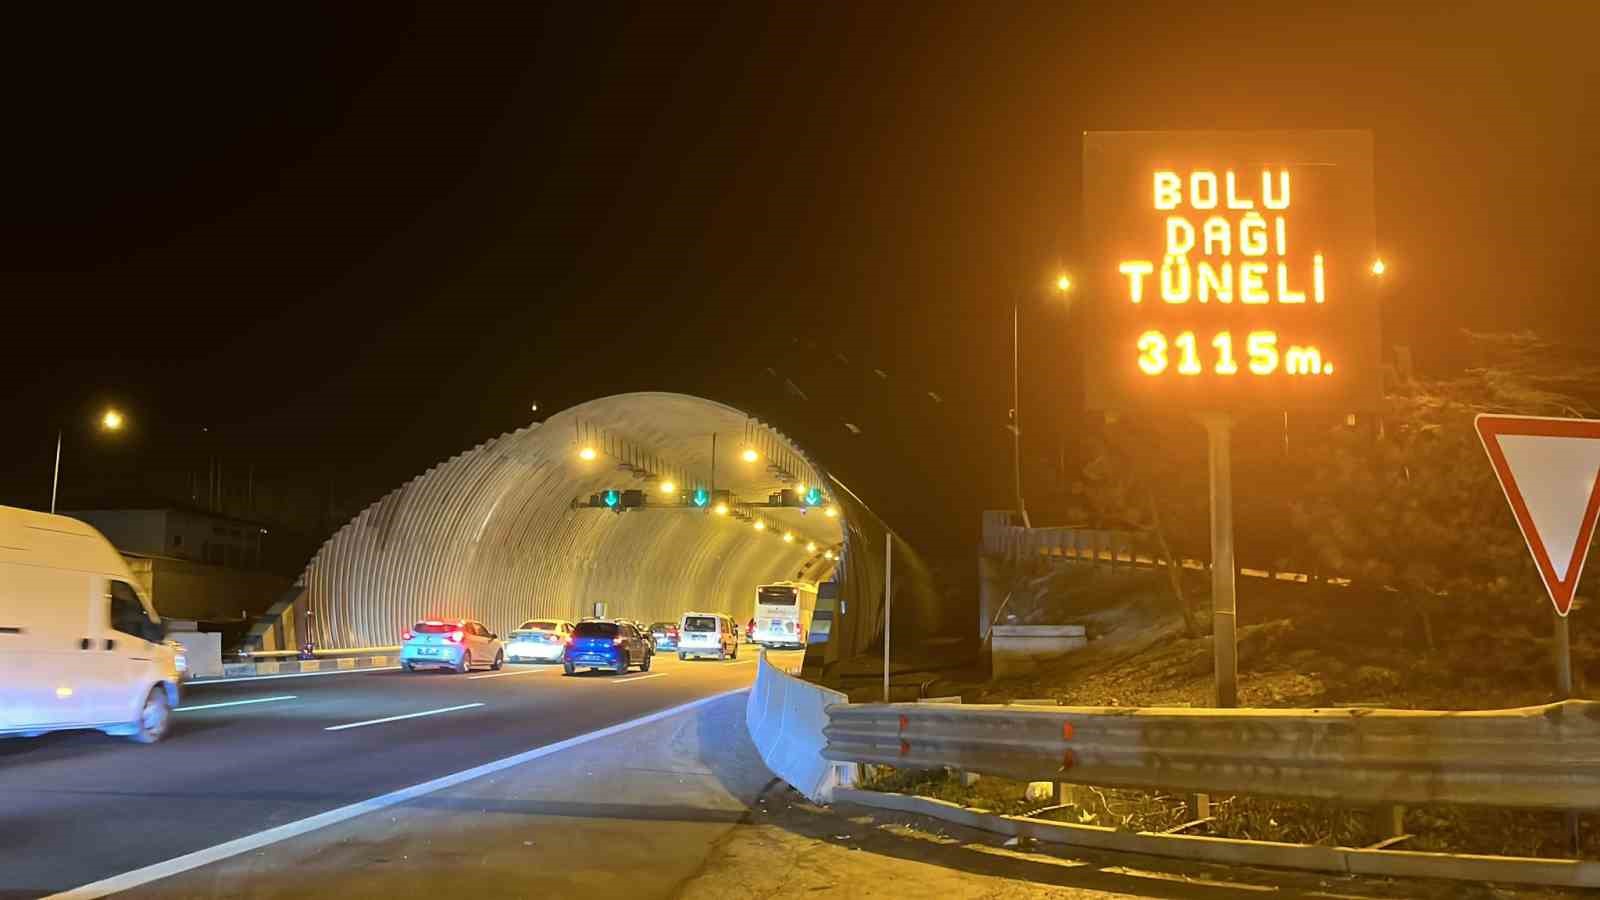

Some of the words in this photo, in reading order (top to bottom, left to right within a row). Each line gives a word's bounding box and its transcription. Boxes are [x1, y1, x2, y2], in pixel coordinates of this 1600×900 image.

[1153, 170, 1291, 210] BOLU
[1165, 210, 1286, 256] DAĞI
[1119, 253, 1326, 304] TÜNELİ
